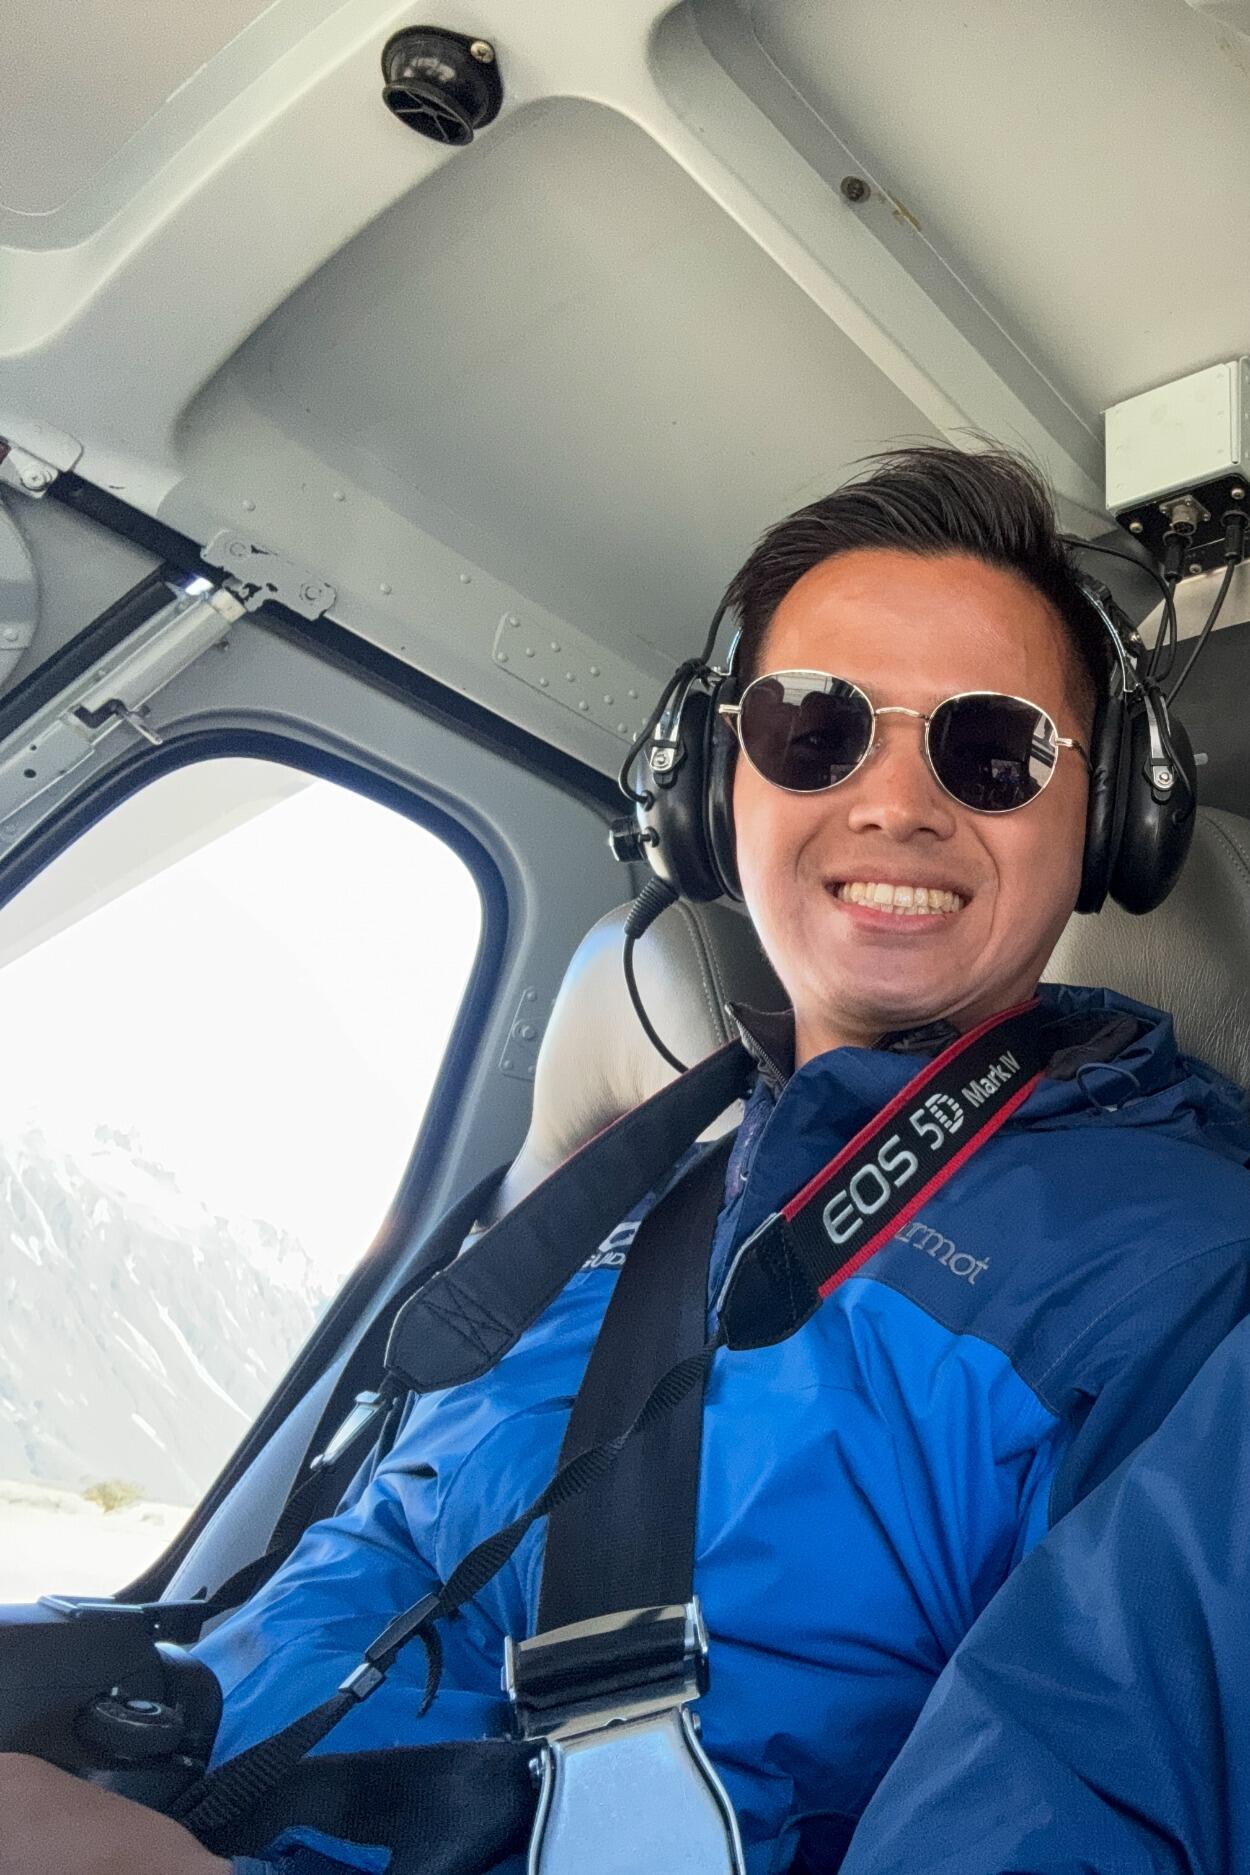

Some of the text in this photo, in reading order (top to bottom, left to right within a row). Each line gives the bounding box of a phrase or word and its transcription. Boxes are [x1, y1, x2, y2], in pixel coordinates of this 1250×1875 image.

[823, 1050, 1021, 1244] EOS 5D Mark IV
[895, 1222, 990, 1285] rmot
